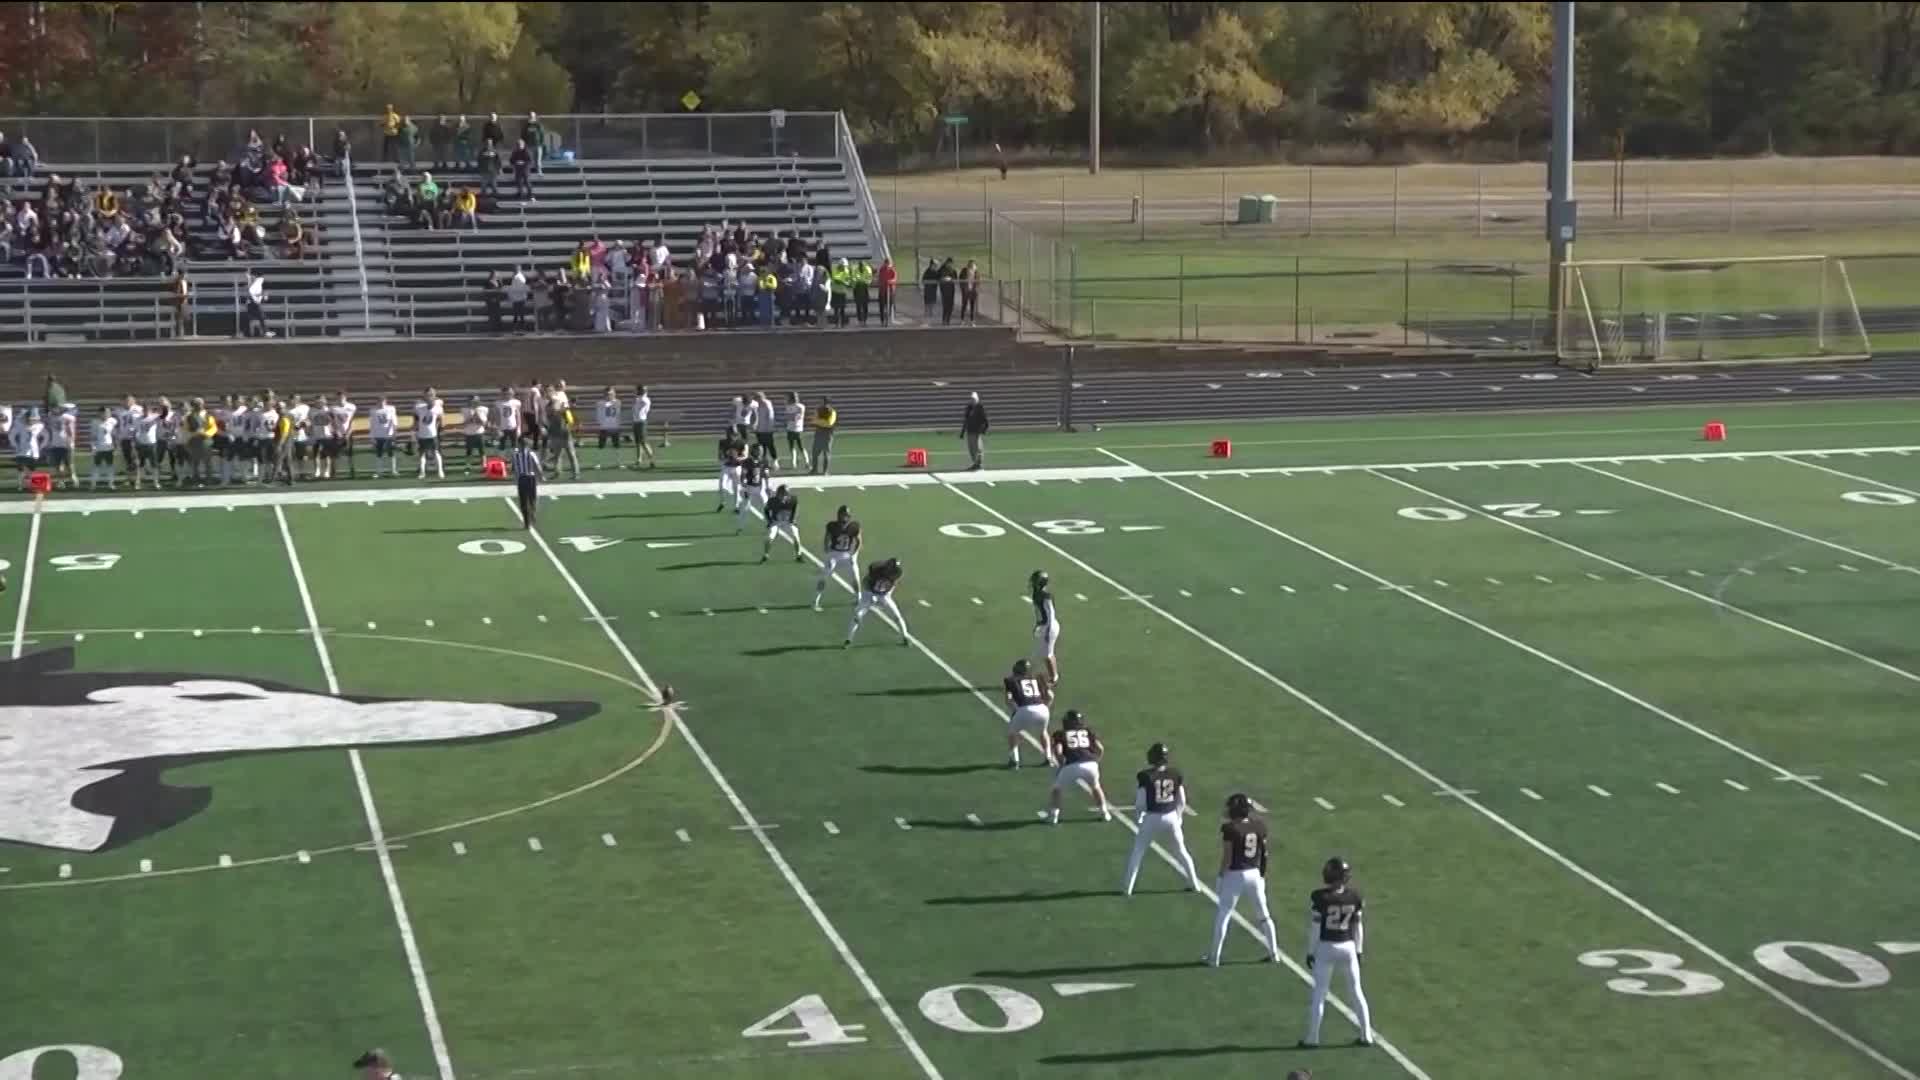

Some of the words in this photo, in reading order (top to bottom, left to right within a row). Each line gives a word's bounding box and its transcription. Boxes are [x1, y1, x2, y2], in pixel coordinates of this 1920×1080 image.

[909, 450, 925, 465] 30
[458, 536, 621, 555] 40
[1020, 678, 1042, 698] 51
[1065, 729, 1090, 748] 56
[1154, 778, 1175, 804] 12
[1244, 832, 1258, 859] 9
[1325, 904, 1356, 931] 27
[1578, 942, 1891, 996] 30
[742, 983, 1044, 1047] 40
